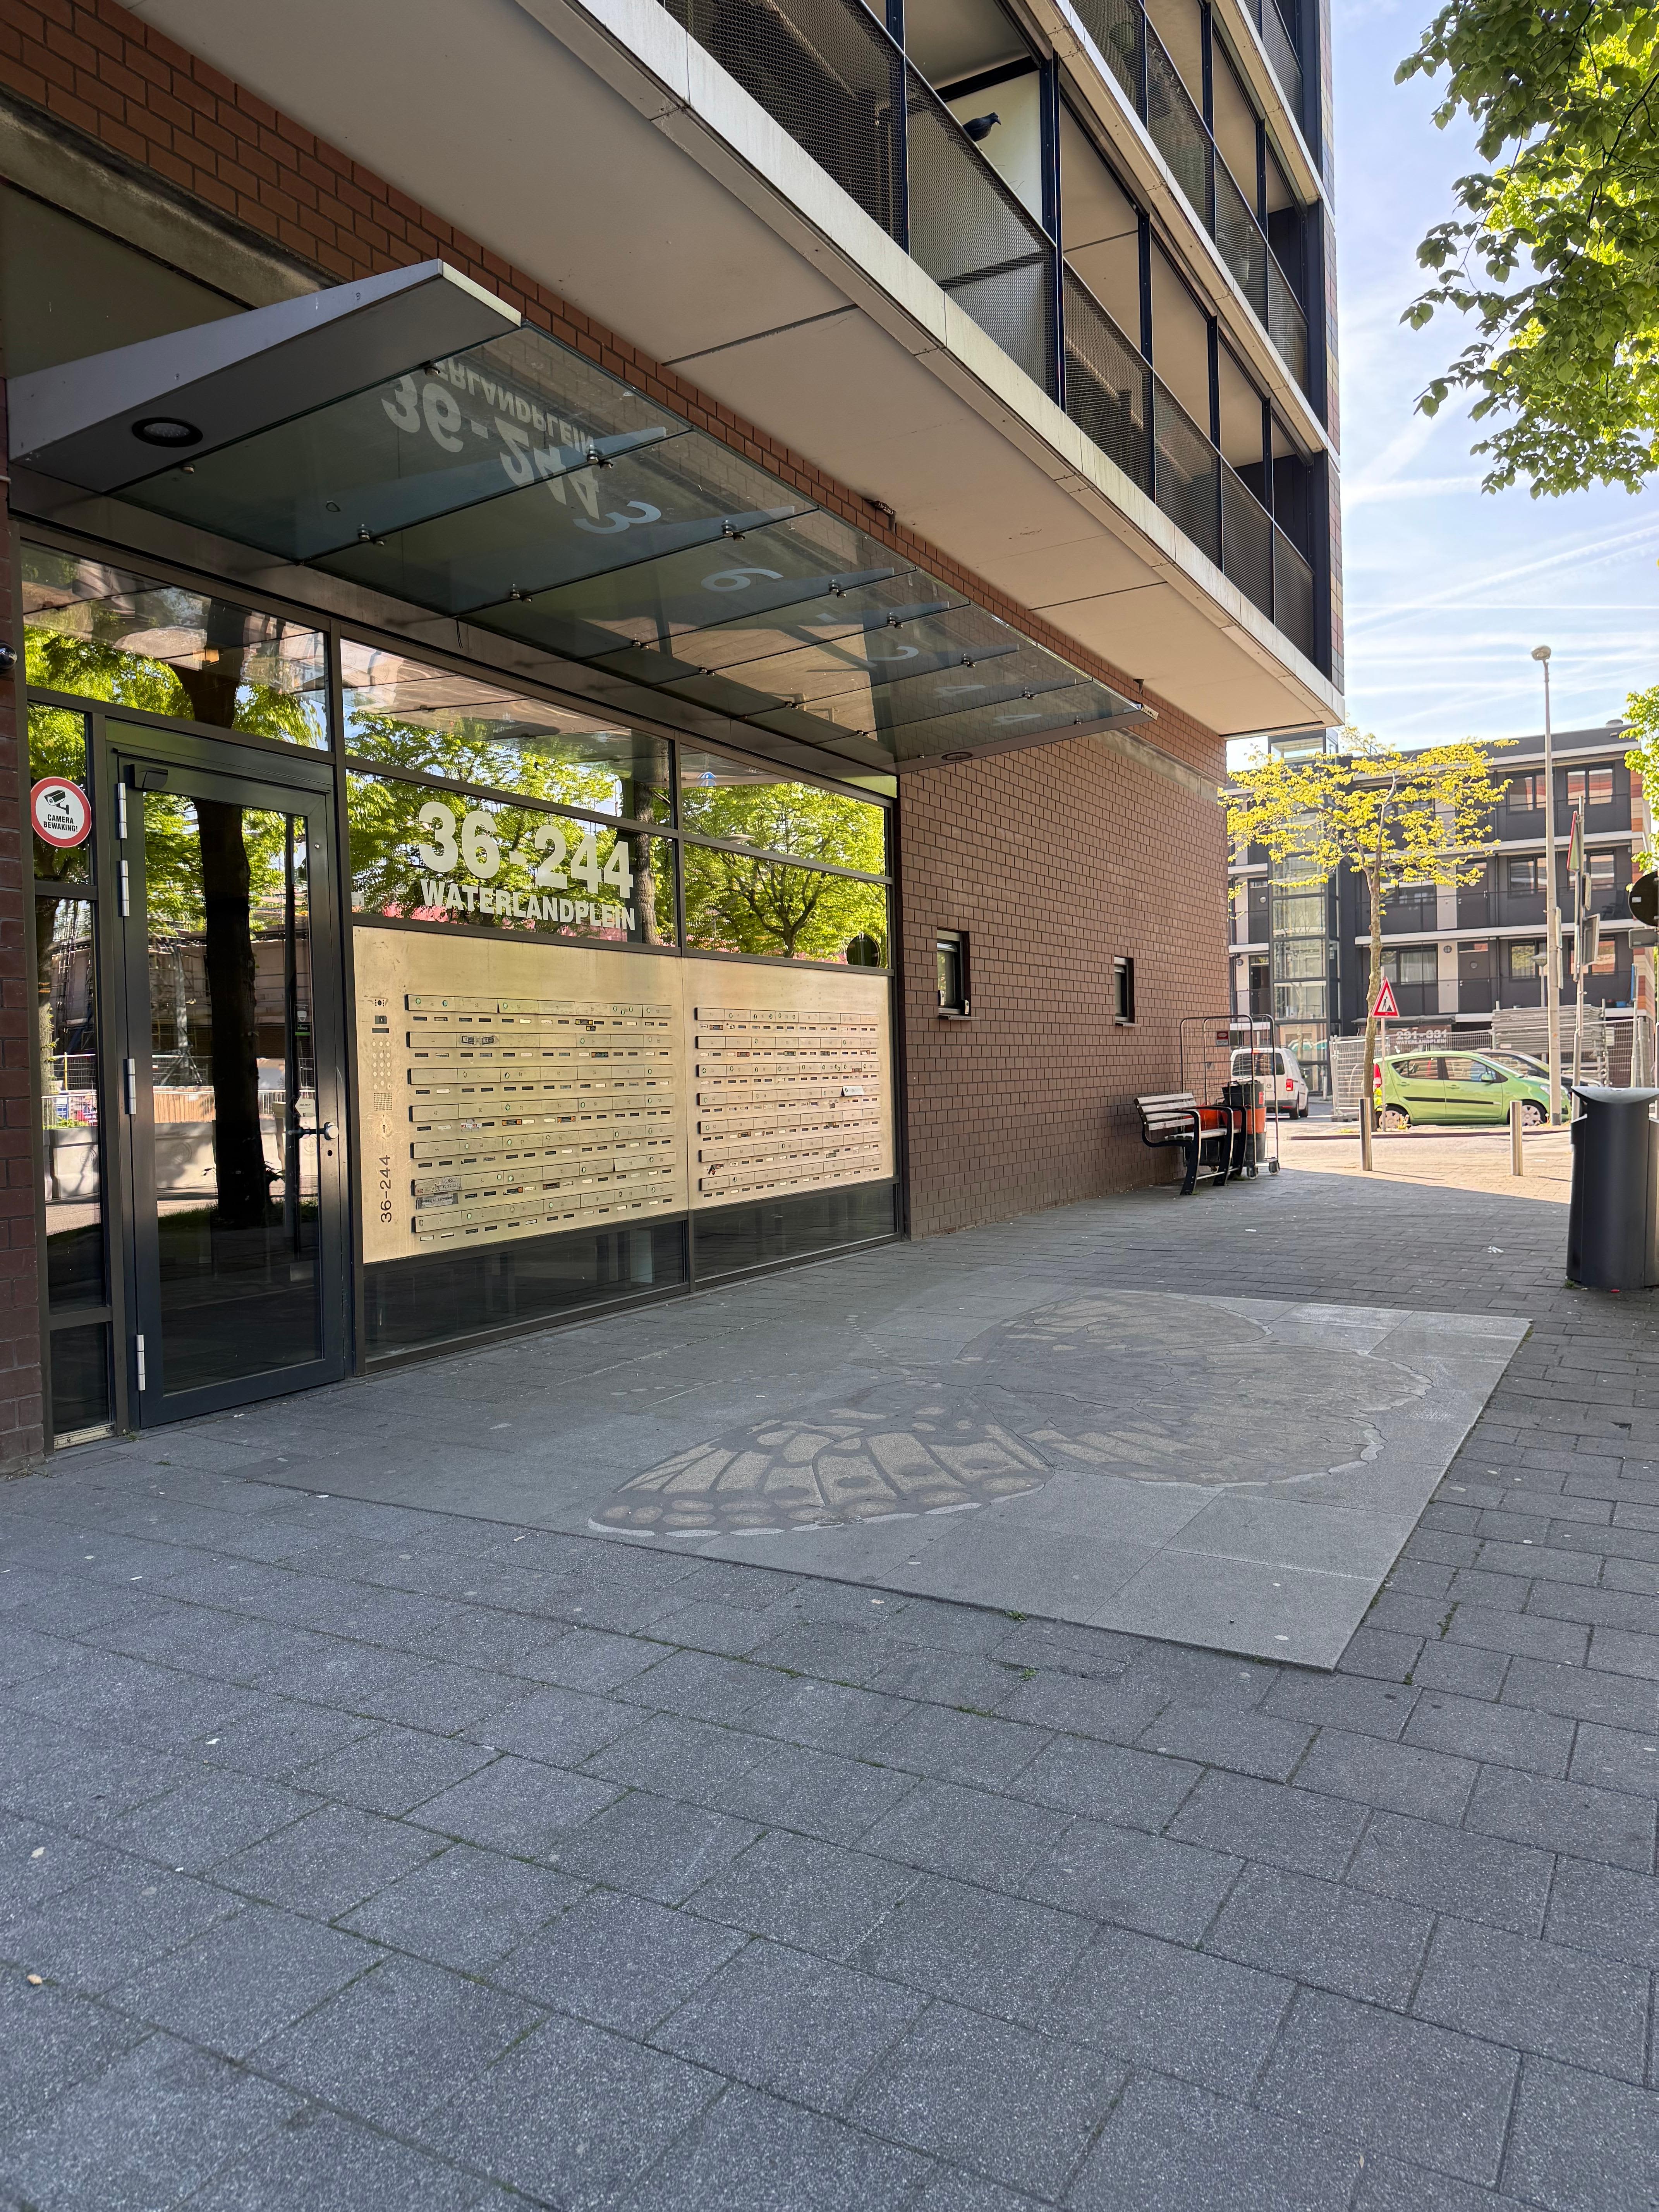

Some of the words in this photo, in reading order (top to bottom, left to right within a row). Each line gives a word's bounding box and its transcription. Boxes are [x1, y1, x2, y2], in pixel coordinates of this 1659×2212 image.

[43, 821, 78, 832] BEWAKING!
[47, 814, 74, 824] CAMERA
[419, 801, 634, 899] 36-244
[420, 879, 635, 930] WATERLANDPLEIN
[379, 1155, 392, 1223] 36-244
